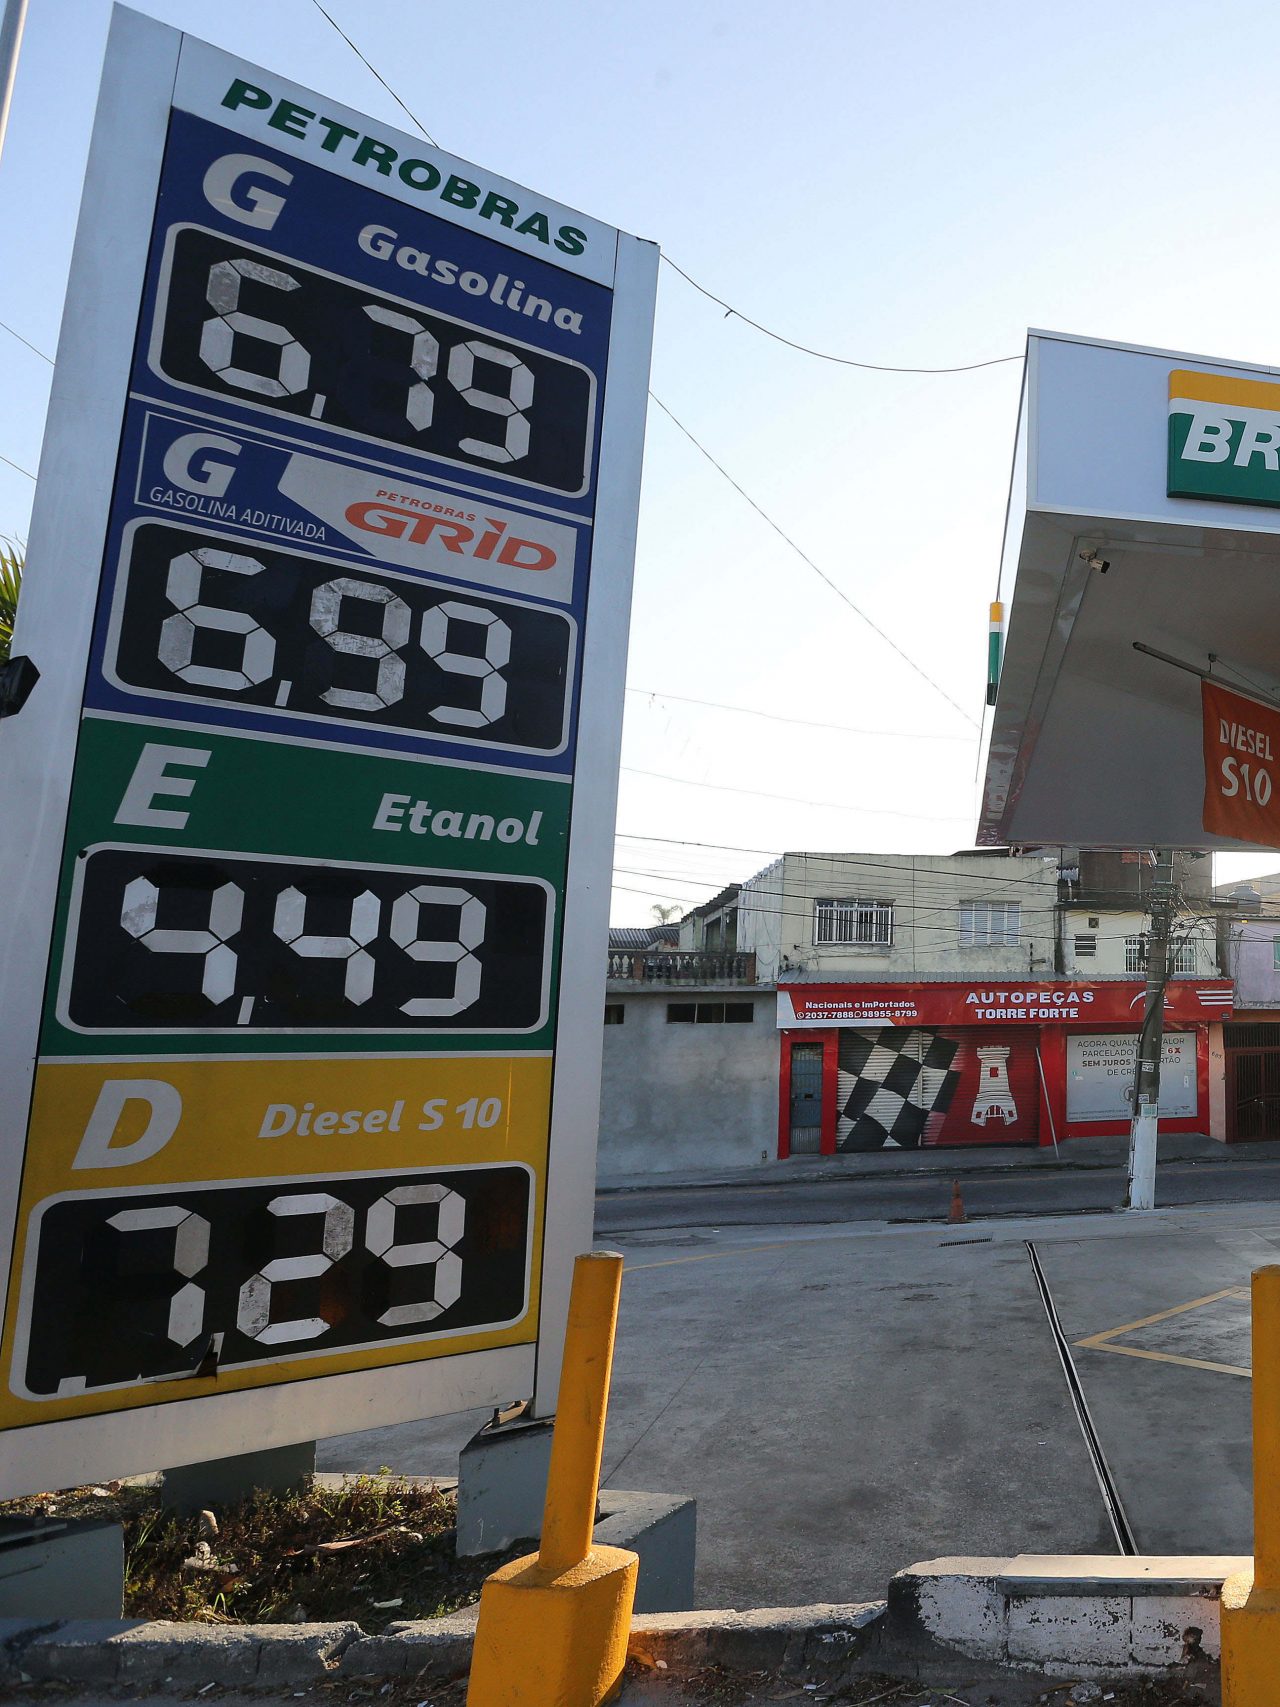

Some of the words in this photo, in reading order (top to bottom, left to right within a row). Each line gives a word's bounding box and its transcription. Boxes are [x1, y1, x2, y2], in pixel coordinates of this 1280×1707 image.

[202, 152, 296, 232] G
[220, 77, 589, 258] PETROBRAS
[357, 223, 584, 335] Gasolina
[199, 258, 536, 464] 6,79
[162, 432, 244, 498] G
[149, 486, 237, 520] GASOLINA
[240, 508, 327, 542] ADITIVADA
[375, 489, 477, 523] PETROBRAS
[157, 546, 512, 729] 6,99
[1218, 718, 1275, 762] DIESEL
[113, 742, 212, 830] E
[1220, 756, 1273, 806] S10
[372, 792, 544, 846] Etanol
[120, 875, 487, 1025] 4,49
[862, 1010, 918, 1018] 98955-8799
[966, 992, 1095, 1005] AUTOPEÇAS
[975, 1008, 1027, 1019] TORRE
[1029, 1008, 1079, 1018] FORTE
[1077, 1040, 1107, 1048] AGORA
[1110, 1039, 1140, 1047] QUALQ
[1162, 1037, 1185, 1045] ALOR
[1082, 1048, 1134, 1057] PARCELADO
[1167, 1047, 1181, 1055] 6X
[1102, 1059, 1131, 1067] JUROS
[1160, 1056, 1181, 1064] RTÃO
[71, 1079, 183, 1171] D
[257, 1100, 405, 1139] Diesel
[418, 1099, 449, 1132] S
[454, 1098, 502, 1131] 10
